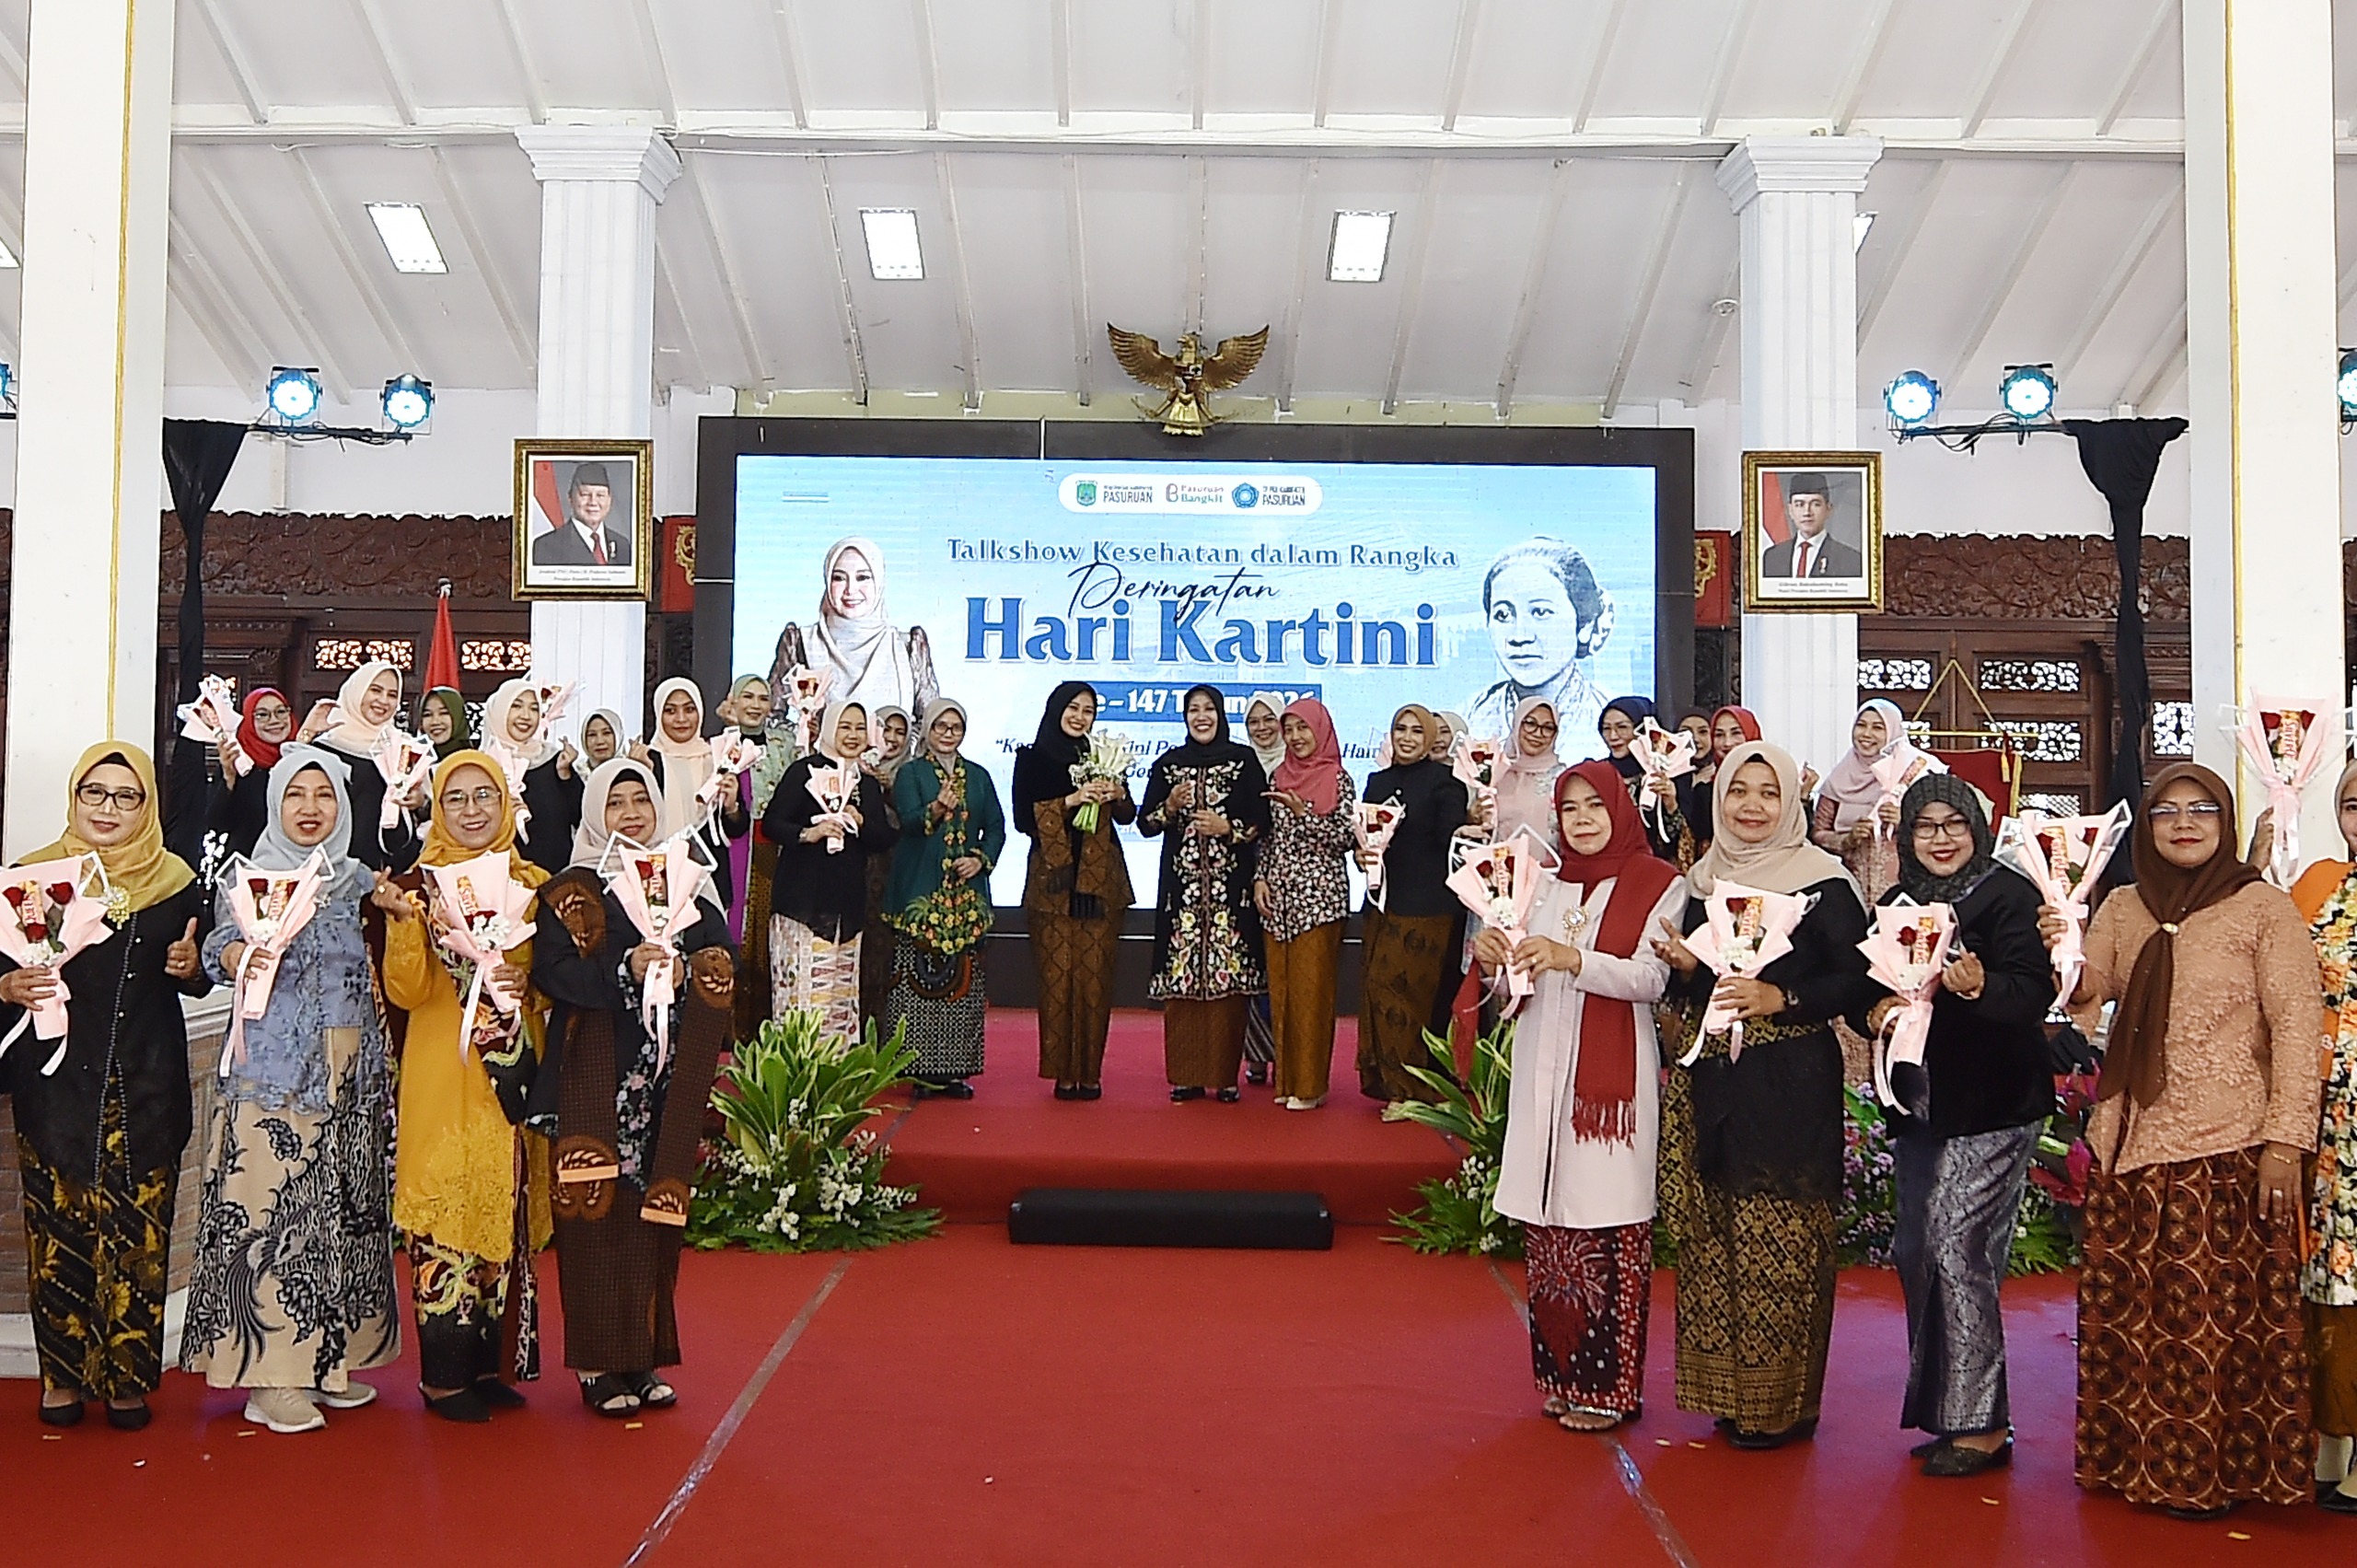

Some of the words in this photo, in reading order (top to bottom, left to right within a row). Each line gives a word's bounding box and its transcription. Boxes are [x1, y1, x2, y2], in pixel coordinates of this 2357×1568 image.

[1103, 491, 1153, 503] PASURUAN
[948, 539, 1081, 561] Talkshow
[1093, 541, 1239, 563] Kesehatan
[1251, 543, 1337, 564] dalam
[1351, 544, 1457, 571] Rangka
[1067, 561, 1280, 623] Peringatan
[965, 598, 1132, 661] Hari
[1158, 599, 1435, 666] Kartini
[1128, 689, 1168, 714] 147
